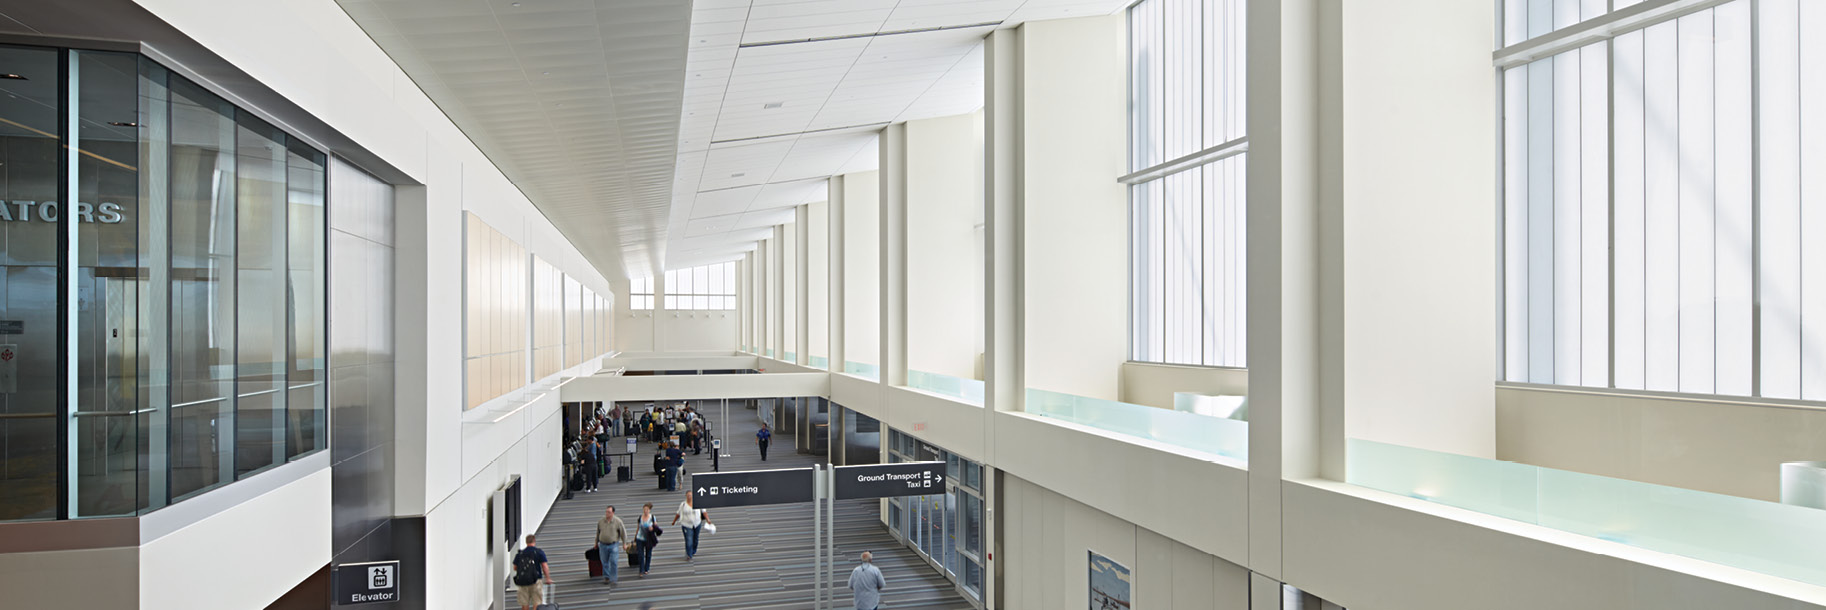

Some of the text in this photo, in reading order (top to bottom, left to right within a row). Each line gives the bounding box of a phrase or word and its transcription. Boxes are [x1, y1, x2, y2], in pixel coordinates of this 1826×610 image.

[857, 472, 921, 482] Ground Transport
[722, 485, 758, 494] Ticketing
[352, 592, 393, 602] Elevator
